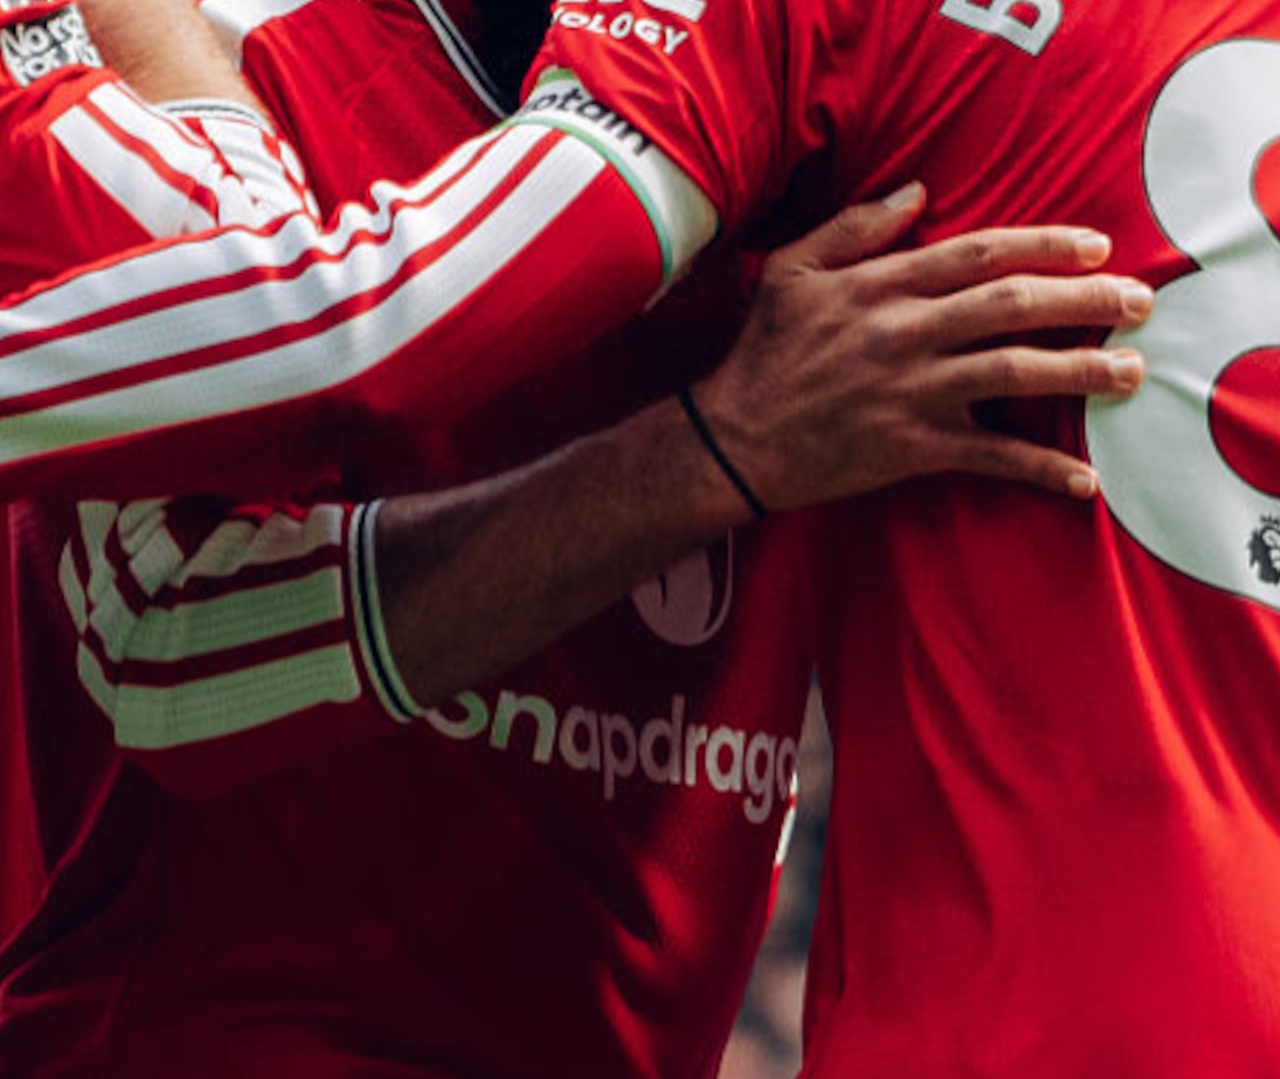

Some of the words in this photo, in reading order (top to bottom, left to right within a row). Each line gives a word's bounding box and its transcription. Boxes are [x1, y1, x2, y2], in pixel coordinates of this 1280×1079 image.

[552, 6, 689, 56] OLOGY
[526, 86, 653, 158] ptain
[426, 689, 799, 825] napdrago
